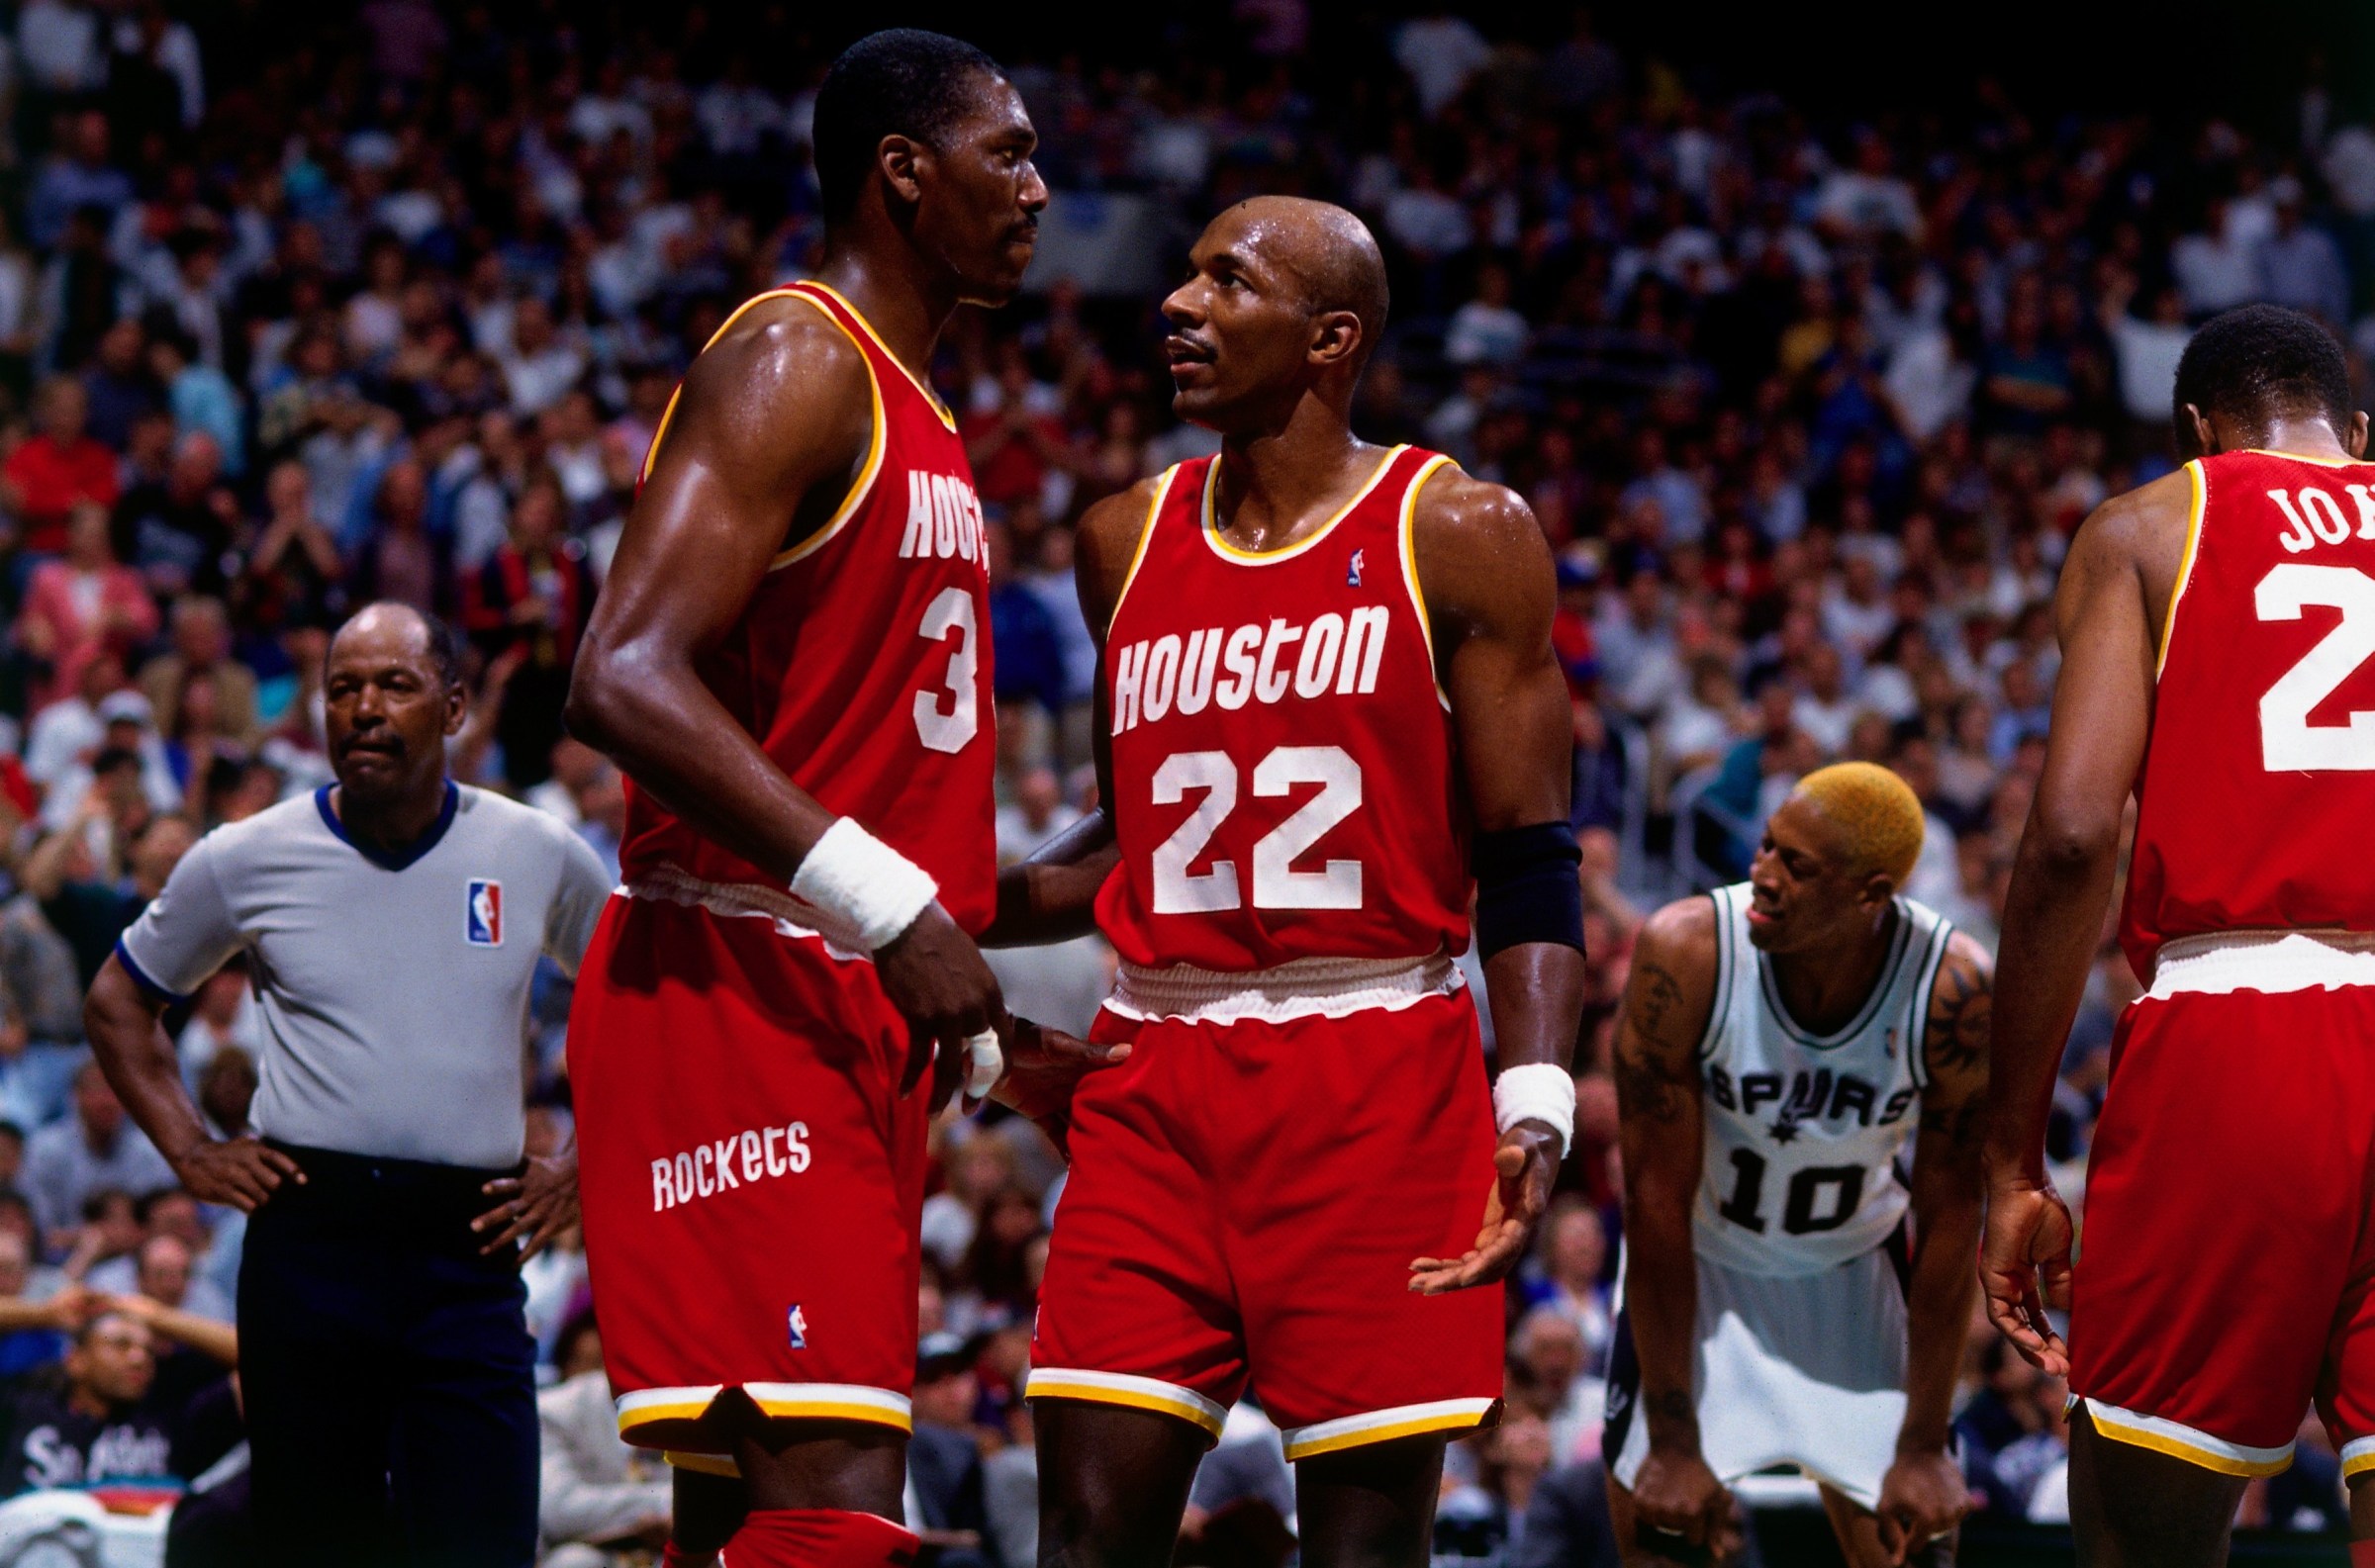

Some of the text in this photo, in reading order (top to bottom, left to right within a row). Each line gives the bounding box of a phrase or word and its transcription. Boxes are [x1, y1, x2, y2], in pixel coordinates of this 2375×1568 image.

[1152, 746, 1363, 914] 22
[1709, 1063, 1920, 1130] SPURS
[1719, 1146, 1866, 1236] 10
